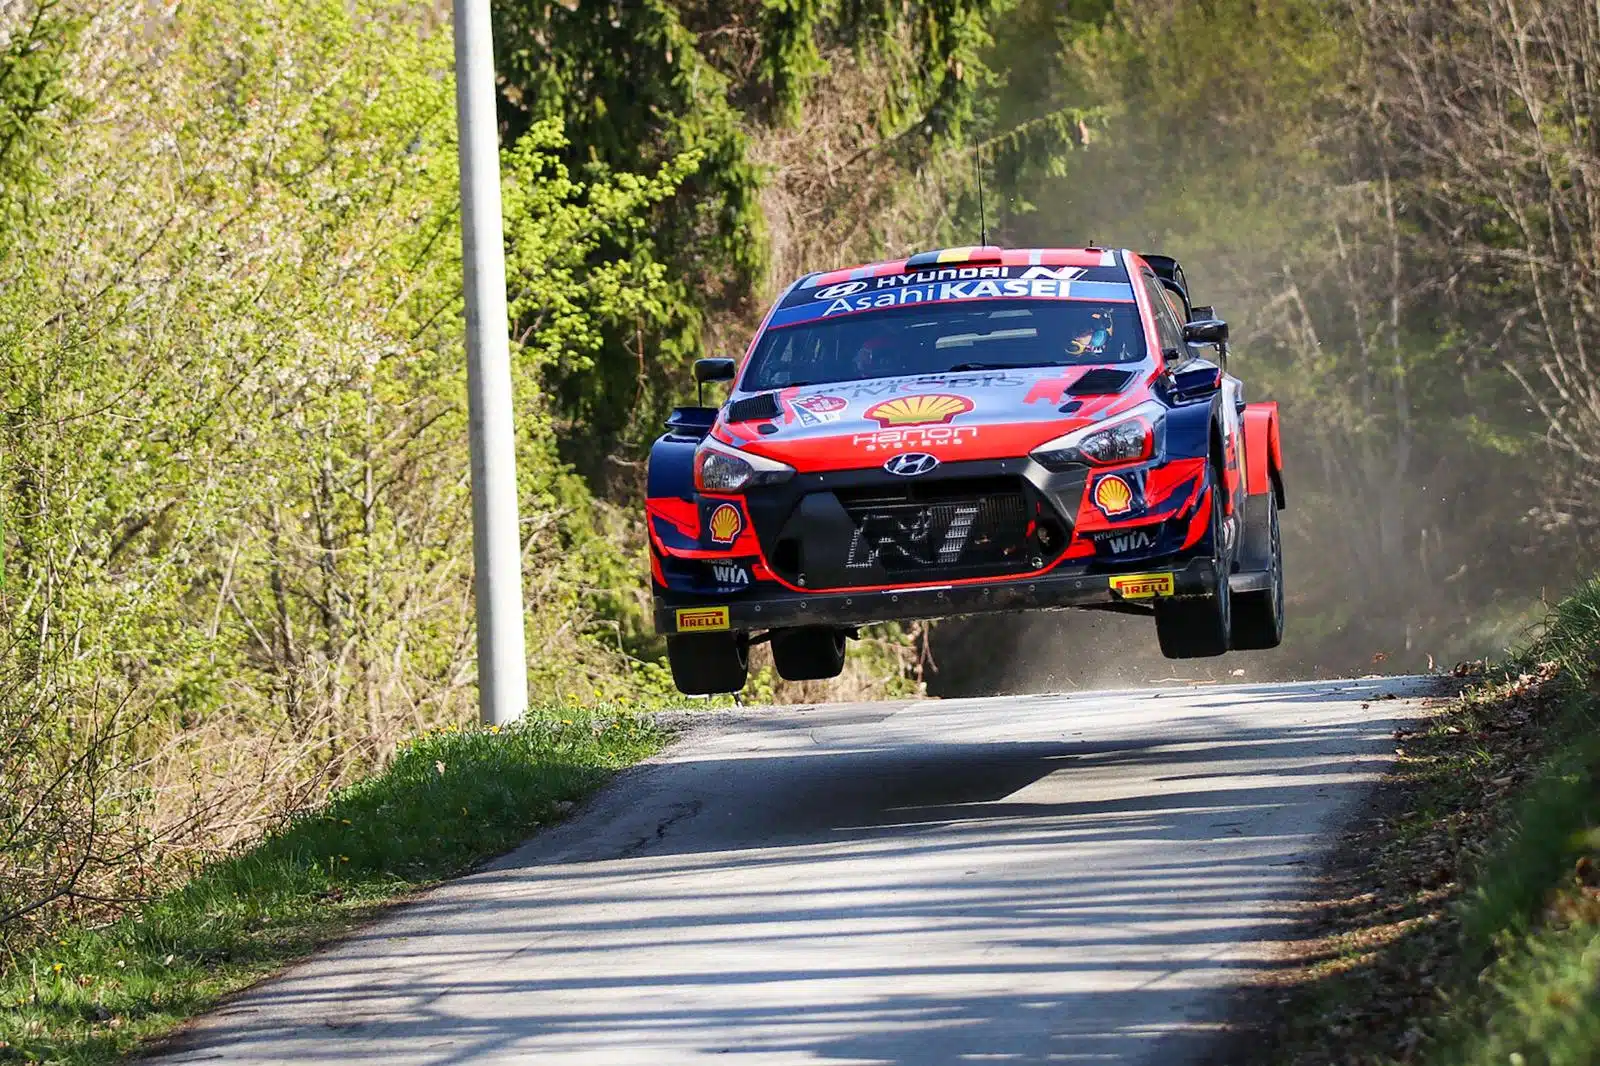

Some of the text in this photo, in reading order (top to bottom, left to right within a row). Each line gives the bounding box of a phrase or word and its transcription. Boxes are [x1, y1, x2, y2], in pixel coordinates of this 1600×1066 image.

[877, 266, 1009, 289] HYUNDAI
[865, 437, 963, 451] SYSTEMS
[1116, 578, 1169, 595] PIRELLI
[680, 611, 724, 627] PIRELLI
